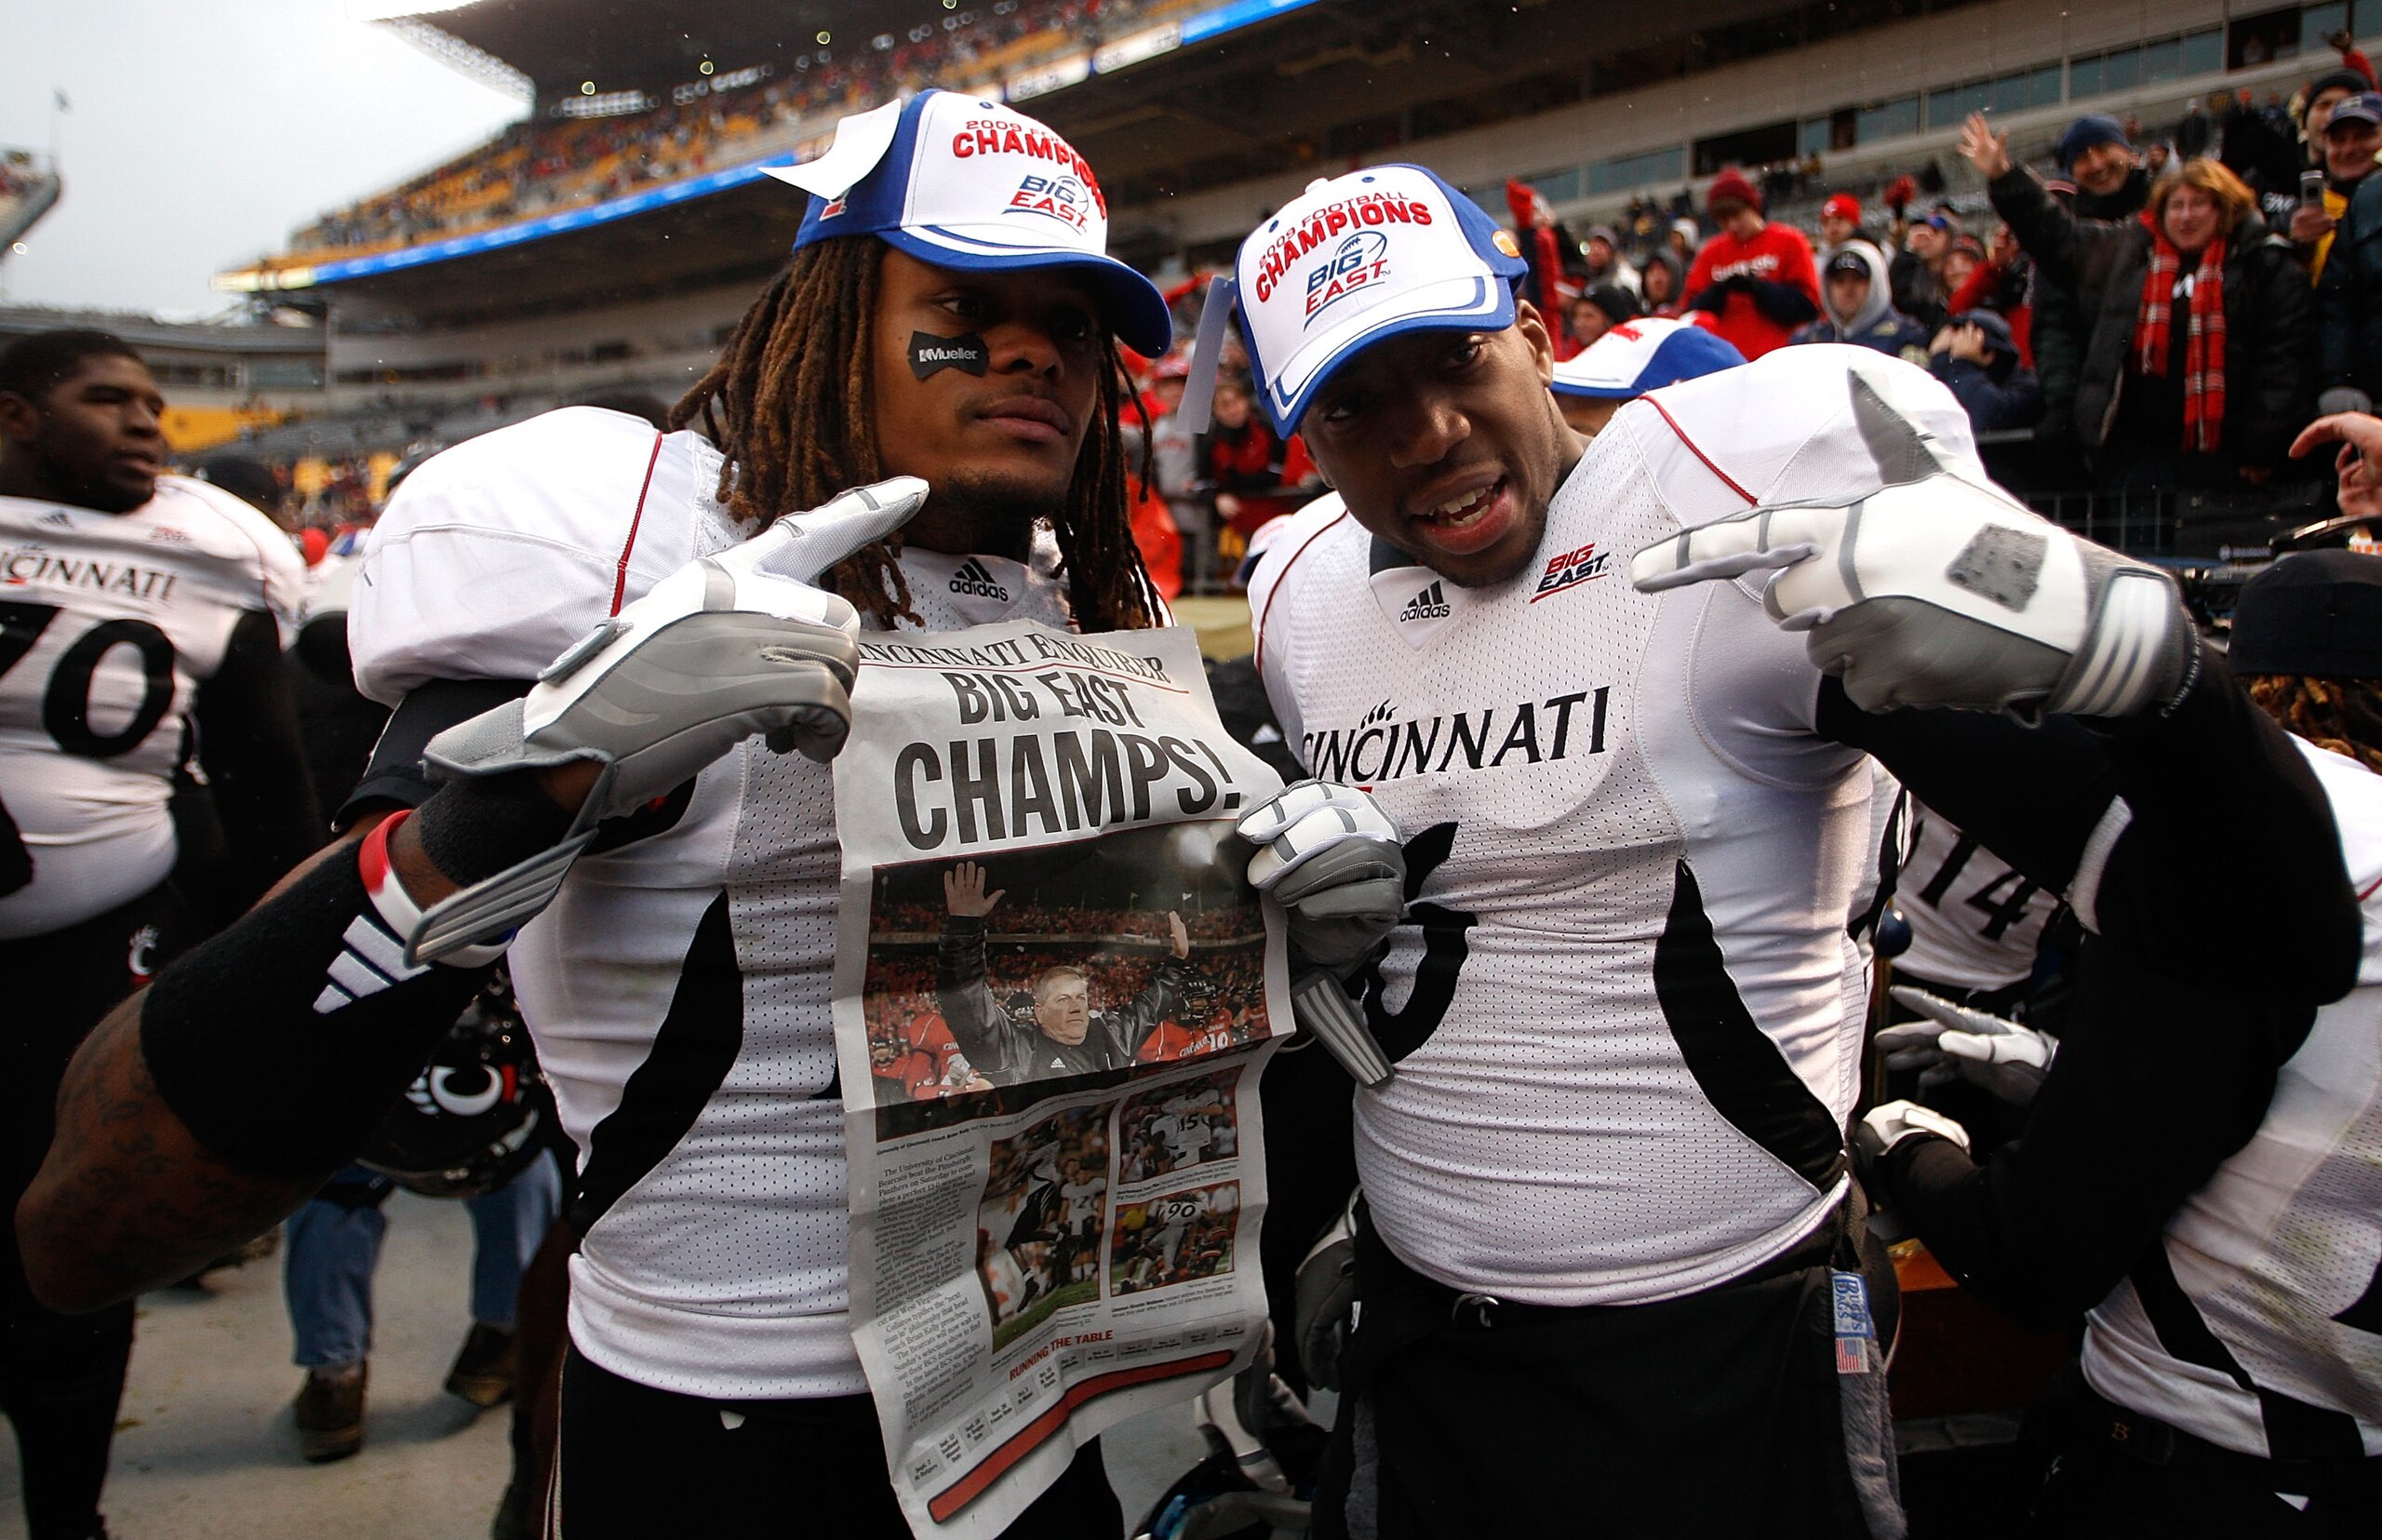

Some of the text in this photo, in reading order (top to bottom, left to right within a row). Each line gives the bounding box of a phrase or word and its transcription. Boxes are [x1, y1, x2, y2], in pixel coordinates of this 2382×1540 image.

[966, 120, 1022, 131] 2009
[1019, 174, 1077, 204] BIG
[1010, 190, 1088, 228] EAST
[1259, 192, 1410, 270] 2009 FOOTBALL
[1255, 200, 1433, 303] CHAMPIONS
[1305, 258, 1388, 316] EAST
[1306, 248, 1364, 296] BIG
[1535, 552, 1611, 593] EAST
[1546, 542, 1596, 575] BIG
[0, 553, 179, 602] CINNATI
[949, 579, 1009, 603] adidas
[1399, 602, 1452, 623] adidas
[859, 633, 1171, 684] INCINNATI ENQUIRER
[941, 670, 1145, 729] BIG EAST
[894, 729, 1241, 851] CHAMPS!
[878, 1173, 907, 1187] Bearcats
[909, 1169, 923, 1178] beat
[938, 1156, 971, 1172] Pittsburgh
[885, 1168, 898, 1176] The
[899, 1158, 933, 1172] University
[878, 1183, 909, 1197] Panthers
[920, 1172, 950, 1185] Saturday
[878, 1195, 895, 1206] plete
[903, 1188, 927, 1200] perfect
[1168, 1203, 1197, 1220] 90
[889, 1313, 900, 1321] and
[901, 1306, 916, 1316] West
[909, 1313, 941, 1333] philosophy
[942, 1306, 953, 1315] that
[954, 1298, 968, 1309] head
[888, 1341, 906, 1353] coach
[906, 1332, 923, 1344] Brian
[924, 1322, 940, 1335] Kelly
[896, 1350, 909, 1360] The
[910, 1337, 935, 1352] Bearcats
[961, 1318, 971, 1327] wait
[922, 1341, 947, 1357] selection
[948, 1332, 963, 1343] show
[970, 1321, 981, 1332] find
[923, 1356, 937, 1367] BCS
[941, 1357, 953, 1367] BCS
[1009, 1346, 1050, 1382] RUNNING
[1050, 1336, 1073, 1352] THE
[1075, 1330, 1114, 1346] TABLE
[2111, 1424, 2129, 1441] B
